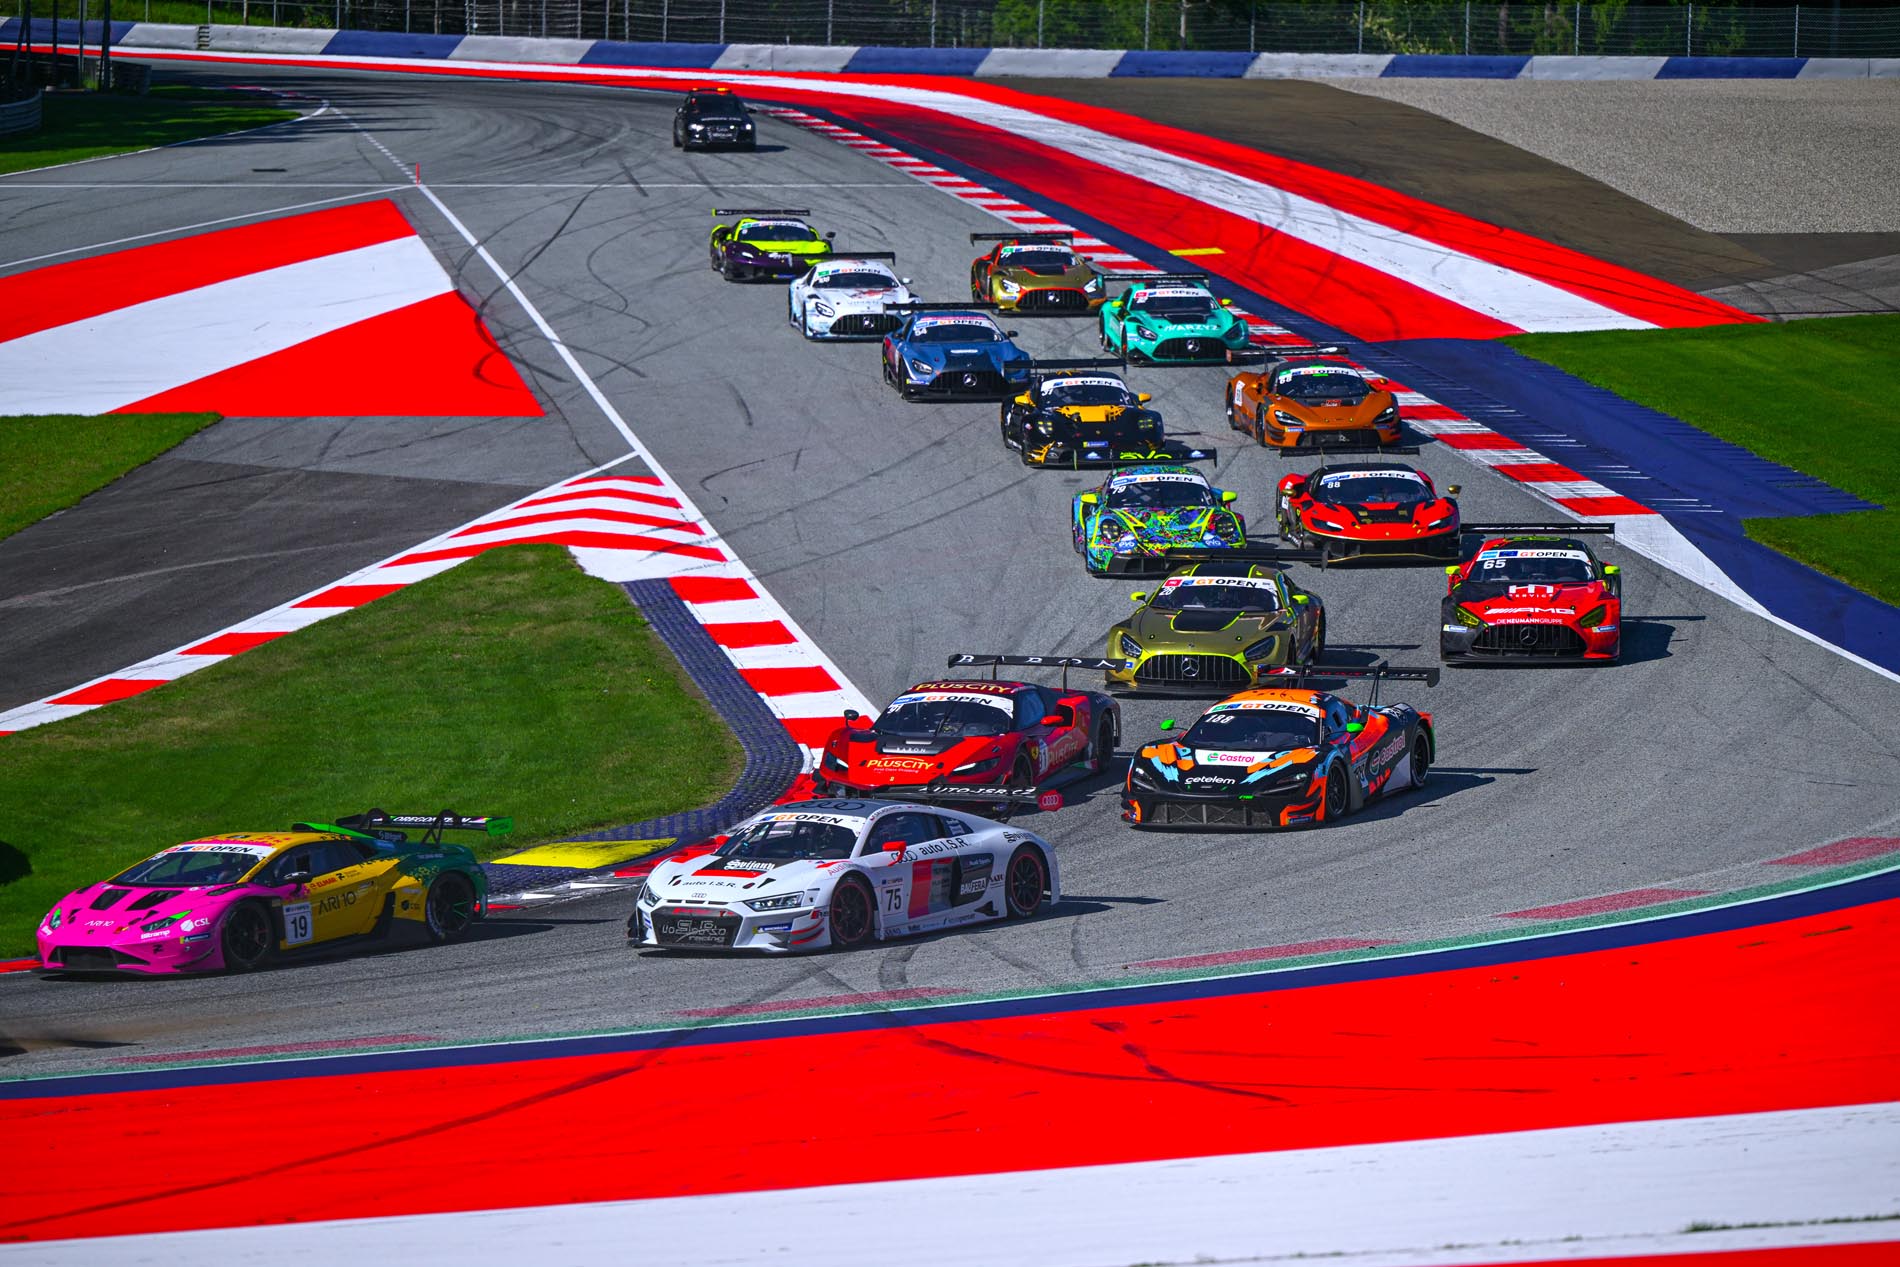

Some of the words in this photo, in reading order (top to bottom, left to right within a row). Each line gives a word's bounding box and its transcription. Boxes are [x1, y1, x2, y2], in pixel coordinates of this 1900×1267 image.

[1112, 485, 1127, 495] 79
[1483, 559, 1506, 569] 65
[1195, 578, 1258, 588] GTOPEN
[916, 681, 1012, 693] PLUSCITY
[925, 694, 993, 706] GTOPEN
[1241, 702, 1312, 714] GTOPEN
[1204, 713, 1234, 724] 188
[1218, 752, 1256, 764] Castrol
[866, 759, 936, 771] PLUSCITY
[1184, 774, 1237, 785] cetelem
[774, 813, 844, 824] GTOPEN
[192, 845, 254, 853] GTOPEN
[920, 842, 943, 856] auto
[318, 895, 340, 916] ARI
[886, 888, 902, 912] 75
[194, 917, 211, 928] CSL
[290, 914, 308, 939] 19
